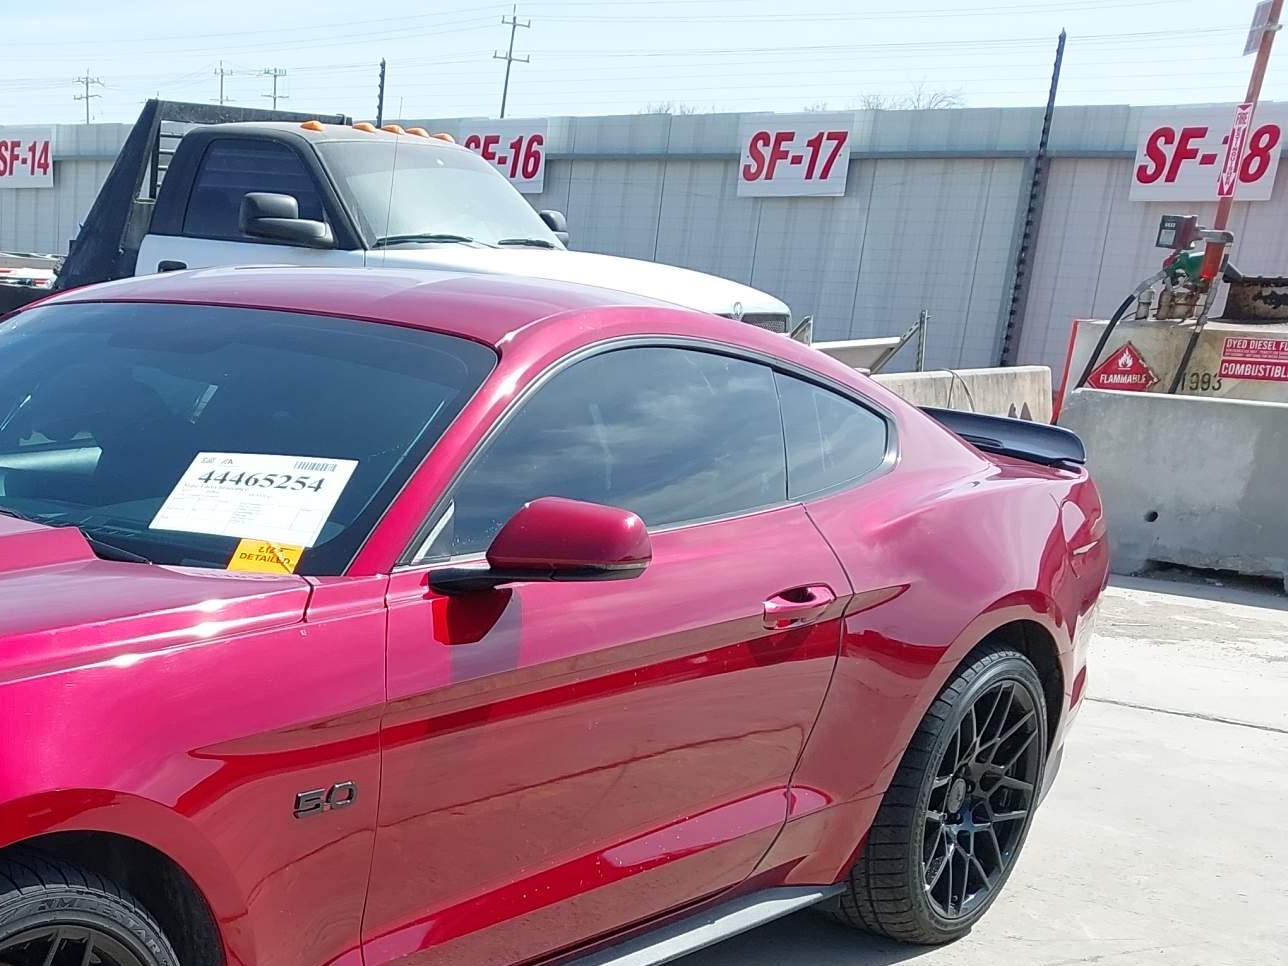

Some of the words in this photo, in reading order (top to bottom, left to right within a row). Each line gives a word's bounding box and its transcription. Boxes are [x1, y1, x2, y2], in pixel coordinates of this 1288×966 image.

[742, 131, 849, 182] SF-17
[1136, 124, 1281, 184] SF-8
[1226, 338, 1247, 349] DYED
[1249, 340, 1277, 351] DIESEL
[1099, 373, 1146, 384] FLAMMABLE
[1221, 362, 1288, 378] COMBUSTIBL
[198, 469, 326, 493] 44465254
